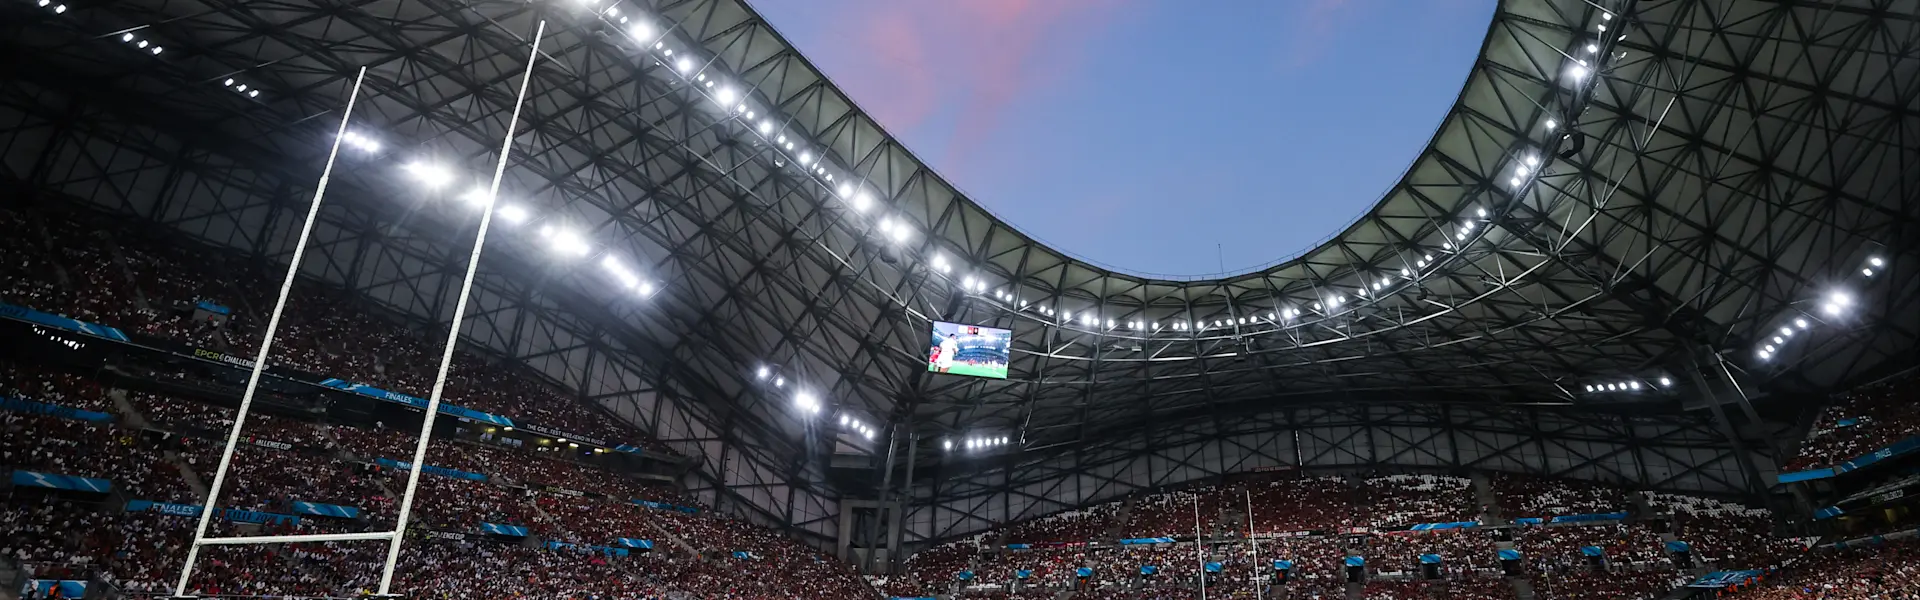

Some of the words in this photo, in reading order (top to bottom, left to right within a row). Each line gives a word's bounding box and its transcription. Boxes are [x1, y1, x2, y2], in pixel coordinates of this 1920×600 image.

[194, 348, 220, 361] EPCR
[385, 391, 413, 404] FINALES
[537, 426, 561, 436] GREEST
